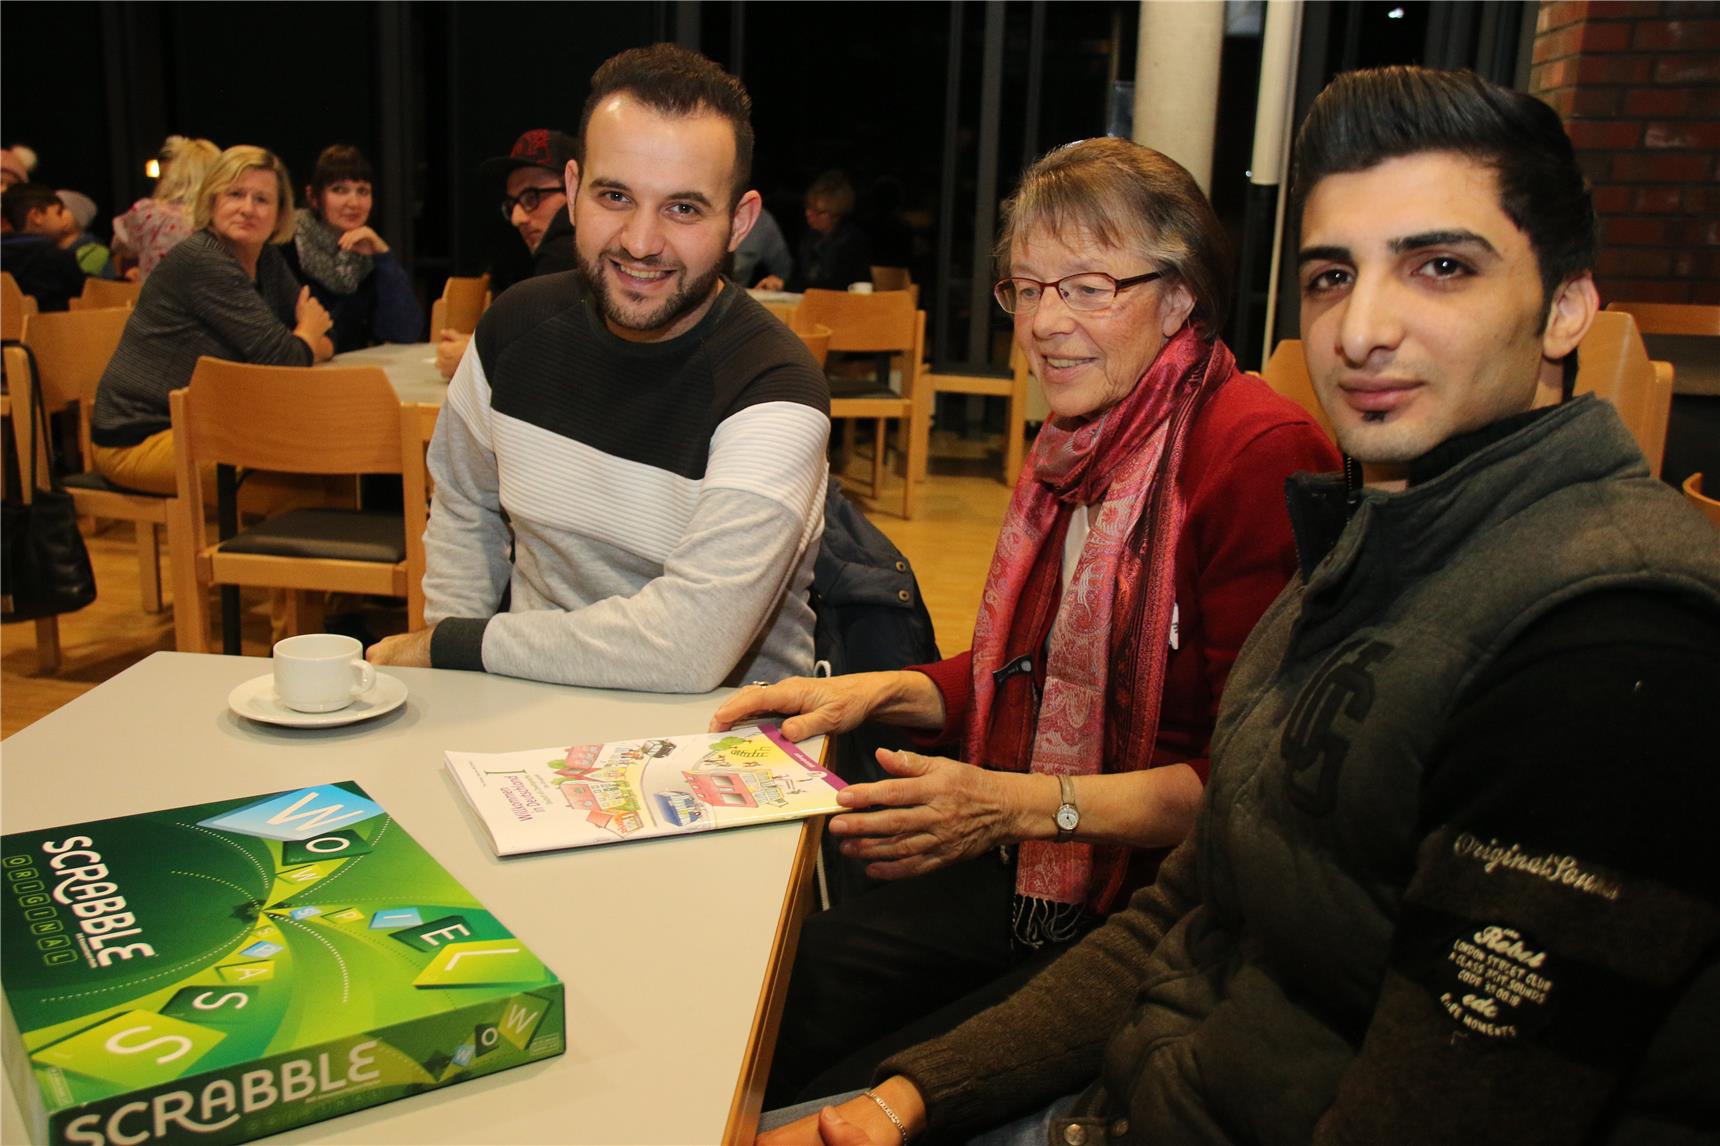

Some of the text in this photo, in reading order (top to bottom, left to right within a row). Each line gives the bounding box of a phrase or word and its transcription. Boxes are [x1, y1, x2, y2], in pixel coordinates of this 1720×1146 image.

[6, 855, 73, 963] ORIGINAL
[42, 835, 157, 968] SCRABBLE
[1454, 938, 1553, 993] LONDON STREET CLUB
[1455, 955, 1486, 975] CLASS
[1509, 978, 1547, 1004] SOUNDS
[1463, 1014, 1517, 1037] MOMENTS
[65, 1040, 382, 1146] SCRABBLE
